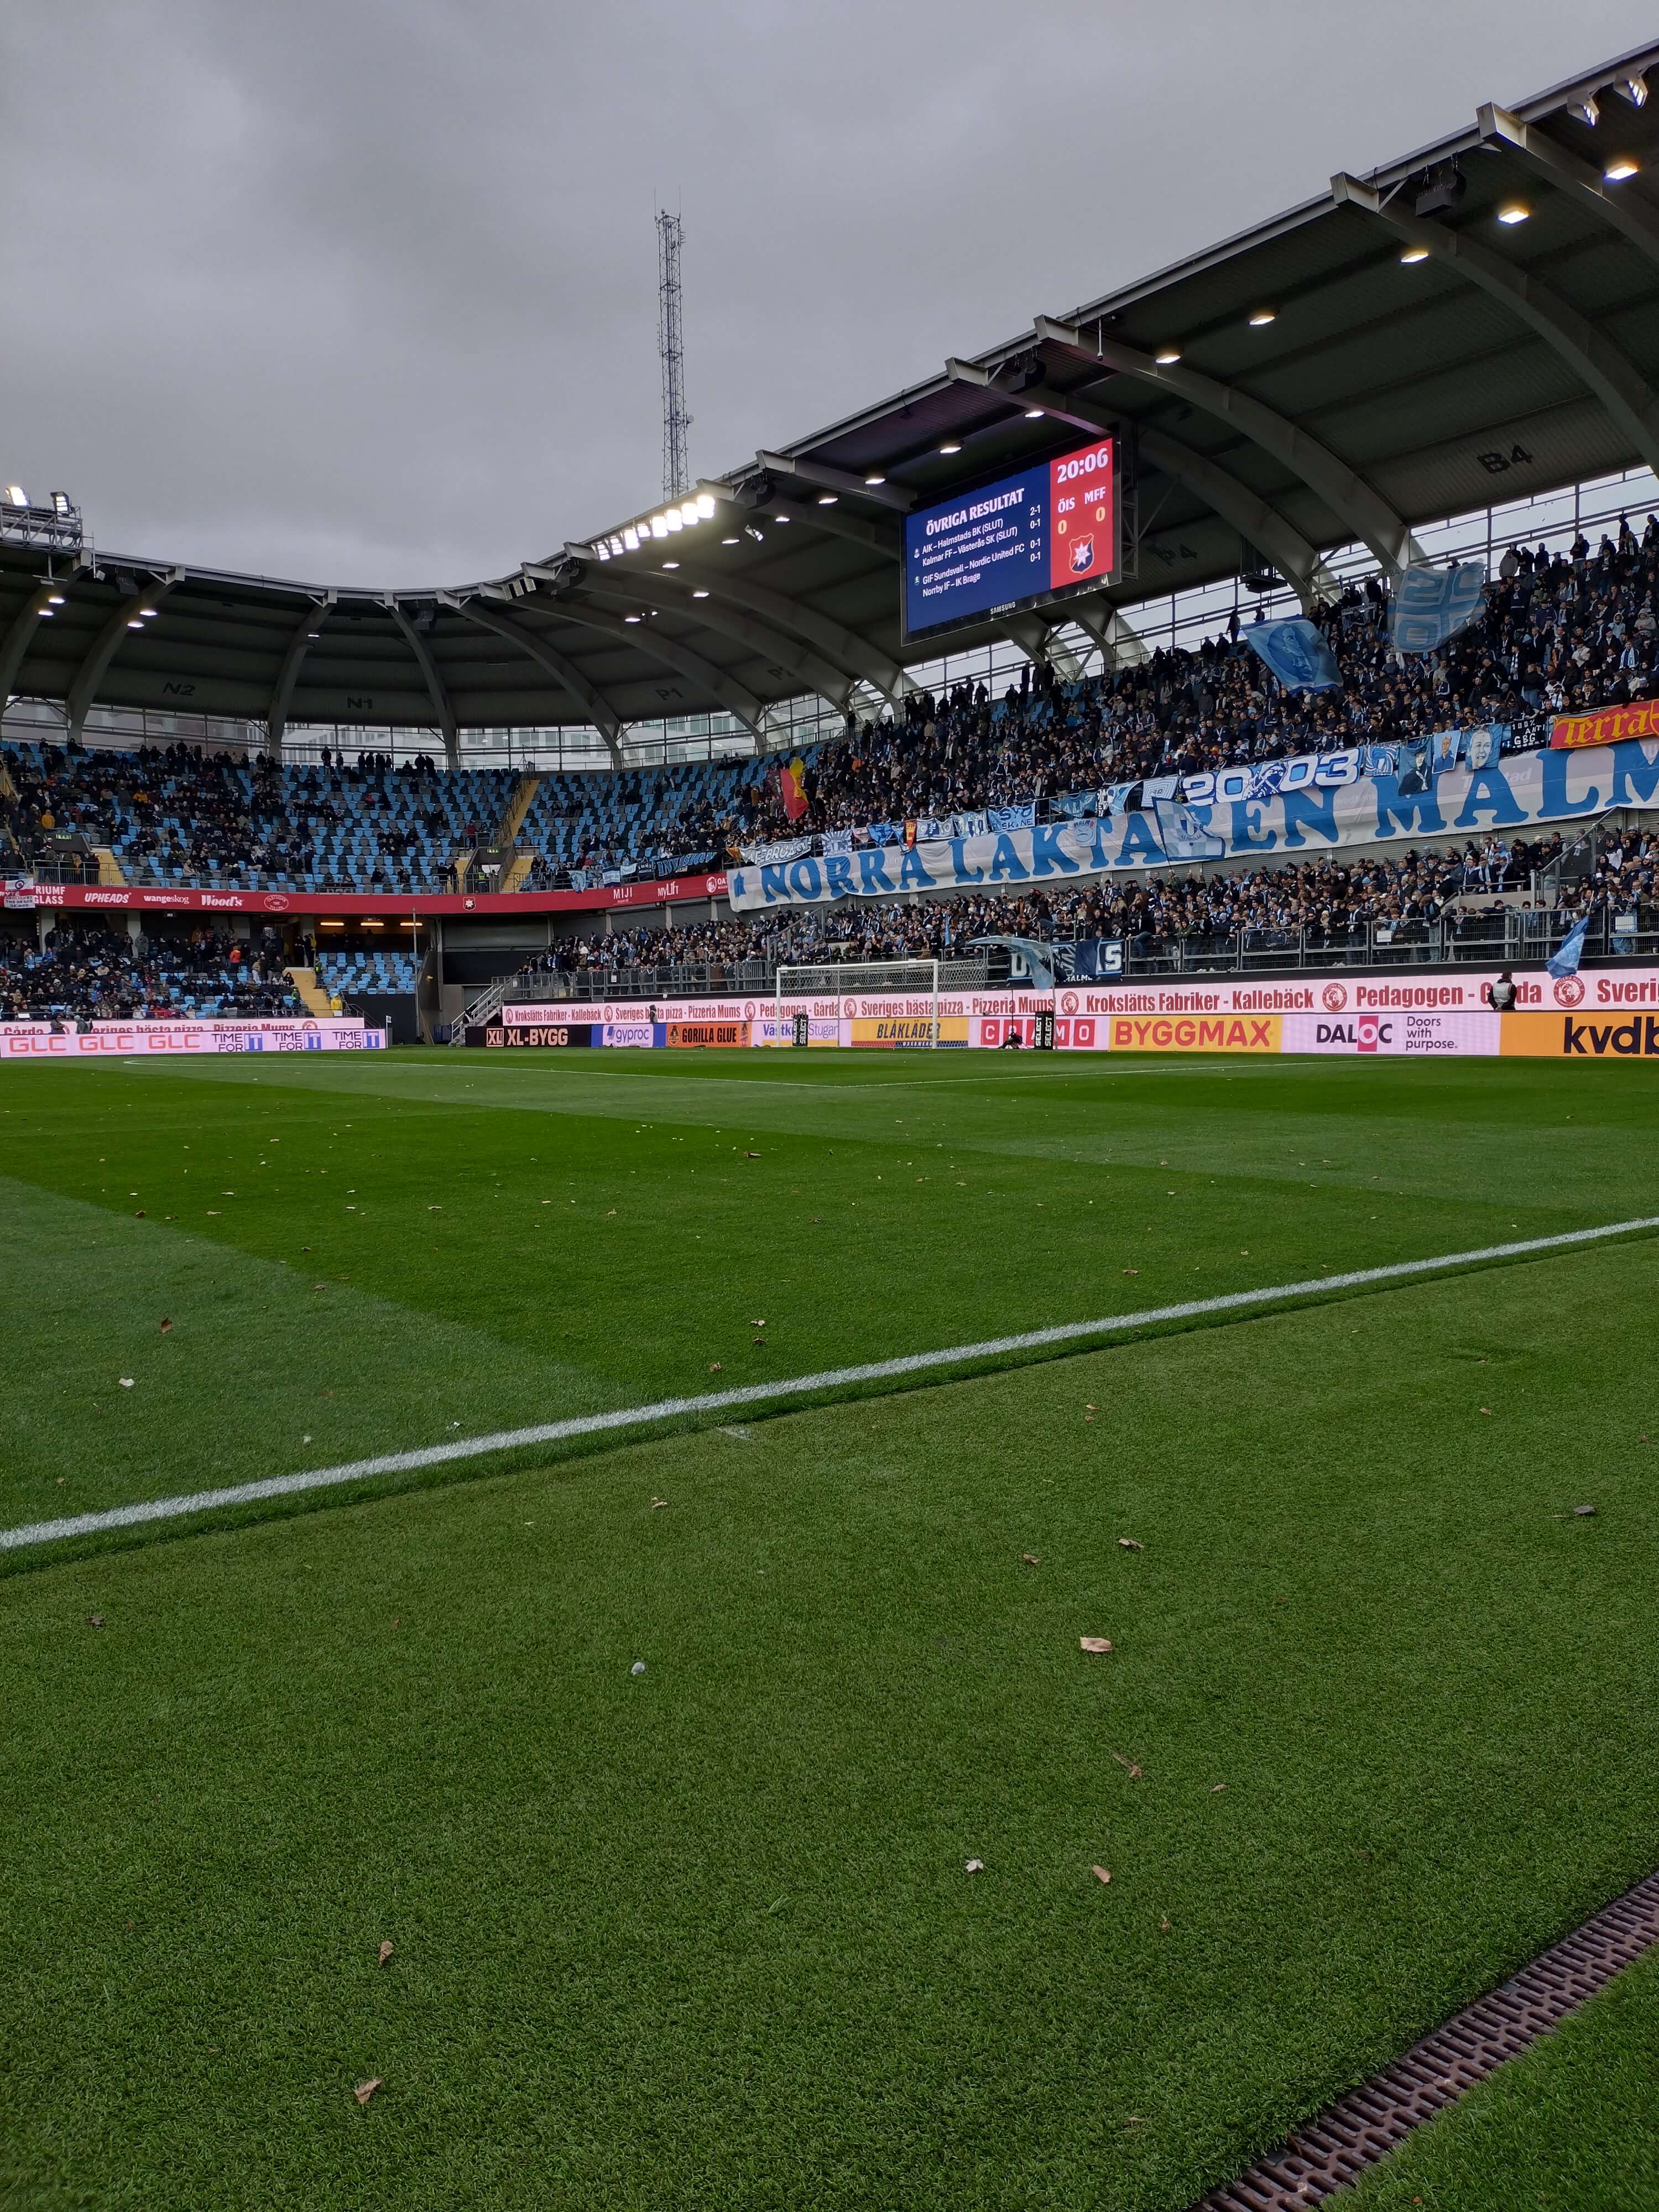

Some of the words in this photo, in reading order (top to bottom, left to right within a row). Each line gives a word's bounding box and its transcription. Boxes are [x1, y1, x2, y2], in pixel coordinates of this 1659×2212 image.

[1057, 447, 1109, 483] 20:06
[1477, 445, 1533, 474] B4
[1084, 487, 1106, 505] MFF
[926, 510, 967, 536] ÖVRIGA
[969, 488, 1025, 520] RESULTAT
[1030, 504, 1040, 516] 2-1
[1057, 497, 1076, 513] ÖIS
[1095, 507, 1106, 522] 0
[1030, 518, 1040, 529] 0-1
[1058, 520, 1067, 535] 0
[922, 544, 933, 555] AIK
[937, 530, 972, 549] Halmstads
[972, 525, 982, 537] BK
[982, 518, 1003, 535] (SLUT)
[1030, 538, 1041, 549] 0-1
[922, 554, 944, 567] Kalmar
[945, 549, 953, 559] FF
[958, 539, 985, 555] Västerås
[985, 534, 995, 545] SK
[996, 526, 1018, 542] (SLUT)
[922, 574, 934, 585] GIF
[934, 564, 964, 581] Sundsvall
[969, 556, 990, 570] Nordic
[992, 547, 1014, 562] United
[1015, 543, 1025, 555] FC
[1030, 551, 1041, 562] 0-1
[922, 584, 943, 598] Norrby
[944, 581, 950, 591] IF
[956, 577, 962, 587] IK
[963, 572, 981, 585] Brage
[990, 602, 1016, 615] SAMSUNG
[163, 681, 196, 696] N2
[347, 697, 373, 709] N1
[1525, 724, 1545, 734] ANTI
[1554, 709, 1650, 745] Terra
[1514, 733, 1536, 745] GBG
[761, 844, 937, 903] NORRA
[33, 885, 65, 895] RIUMF
[613, 886, 632, 900] MIJI
[34, 895, 64, 904] GLASS
[85, 893, 129, 904] UPHEADS
[143, 894, 190, 905] wangeskog
[201, 895, 243, 907] Wood's
[515, 1009, 542, 1022] Krokslätts
[544, 1009, 567, 1021] Fabriker
[571, 1008, 601, 1021] Kallebäck
[615, 1006, 645, 1021] Sveriges
[645, 1006, 664, 1019] bta
[665, 1006, 682, 1021] pizza
[688, 1005, 716, 1019] Pizzeria
[718, 1005, 740, 1018] Mums
[813, 1000, 839, 1017] Gårda
[862, 1000, 904, 1018] Sveriges
[906, 999, 934, 1015] bästa
[937, 999, 963, 1017] pizza
[972, 997, 1015, 1014] Pizzeria
[1018, 997, 1055, 1013] Mums
[1087, 993, 1156, 1013] Krokslätts
[1159, 992, 1220, 1011] Fabriker
[1232, 988, 1314, 1010] Kallebäck
[1357, 983, 1463, 1007] Pedagogen
[1480, 981, 1542, 1005] Gda
[1407, 1016, 1441, 1026] Doors
[211, 1033, 243, 1043] TIME
[273, 1032, 302, 1042] TIME
[332, 1031, 362, 1041] TIME
[507, 1028, 568, 1046] XL-BYGG
[616, 1028, 649, 1043] gyproc
[682, 1027, 714, 1044] GORILLA
[717, 1027, 737, 1043] GLUE
[1115, 1020, 1271, 1047] BYGGMAX
[1316, 1023, 1392, 1044] DALOC
[1407, 1027, 1432, 1038] with
[9, 1036, 67, 1053] GLC
[79, 1035, 134, 1051] GLC
[148, 1034, 200, 1050] GLC
[218, 1044, 243, 1052] FOR
